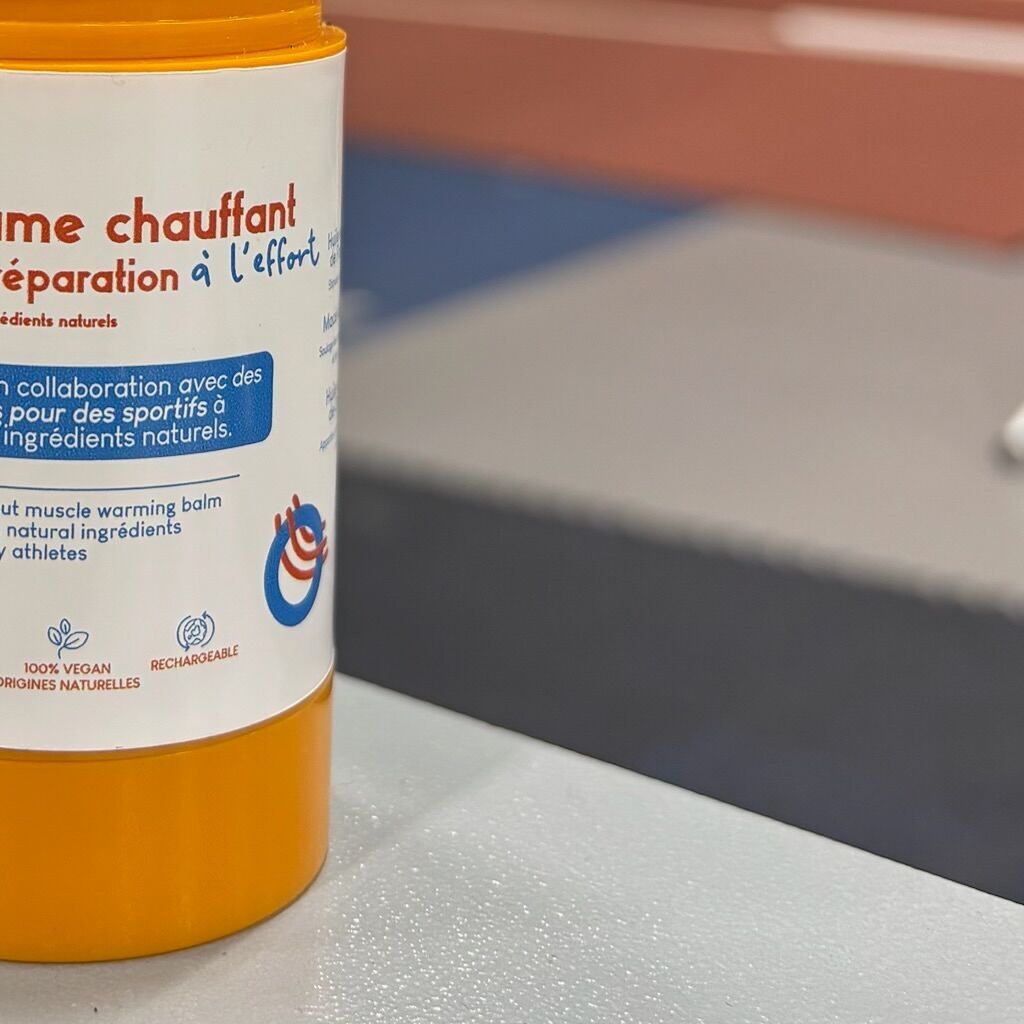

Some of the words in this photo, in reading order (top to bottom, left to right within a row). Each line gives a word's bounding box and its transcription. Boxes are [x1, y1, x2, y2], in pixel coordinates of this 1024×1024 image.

[106, 182, 297, 244] chauffant
[191, 250, 212, 287] à
[231, 228, 320, 283] l'effort
[59, 313, 118, 329] naturels
[17, 375, 172, 398] collaboration
[179, 374, 227, 393] avec
[232, 365, 262, 387] des
[9, 404, 62, 426] pour
[73, 402, 115, 424] des
[122, 396, 208, 425] sportifs
[213, 394, 225, 415] à
[142, 422, 232, 447] naturels.
[25, 502, 91, 519] muscle
[97, 499, 176, 518] warming
[182, 493, 222, 512] balm
[7, 522, 75, 540] natural
[80, 519, 182, 544] ingrédients
[12, 544, 87, 561] athletes
[24, 662, 59, 674] 100%
[63, 663, 111, 675] VEGAN
[150, 645, 240, 671] RECHARGEABLE
[60, 677, 141, 691] NATURELLES
